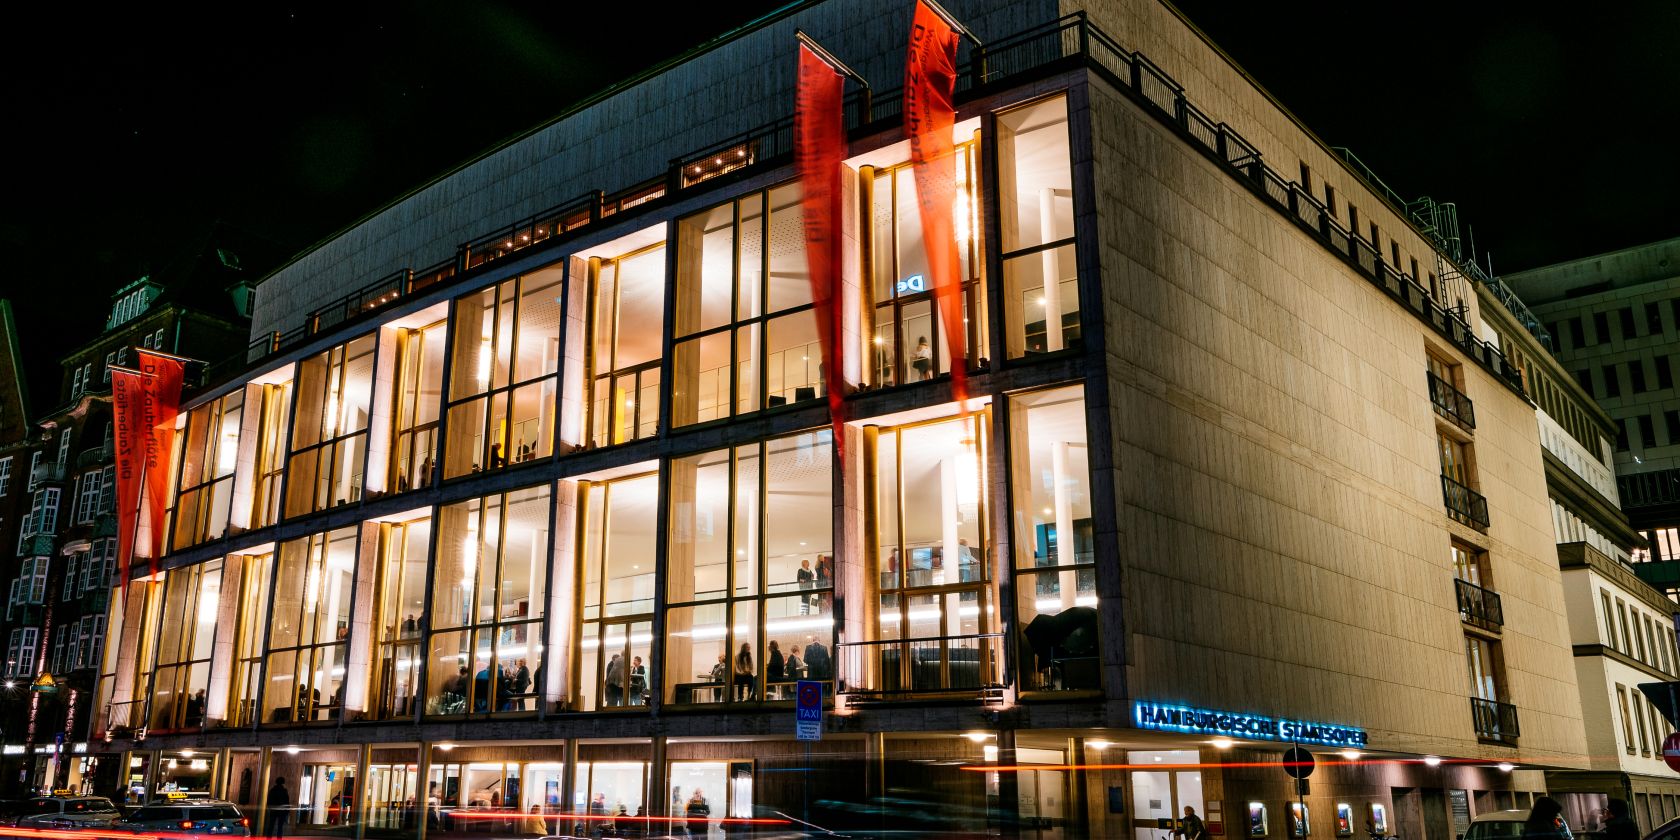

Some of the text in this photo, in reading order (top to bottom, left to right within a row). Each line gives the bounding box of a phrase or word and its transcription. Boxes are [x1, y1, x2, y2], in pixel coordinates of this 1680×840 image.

[144, 365, 158, 468] Die Zauberflöte
[799, 708, 819, 719] TAXI
[1138, 703, 1368, 745] HAMBURGISCHE STAATSOPER
